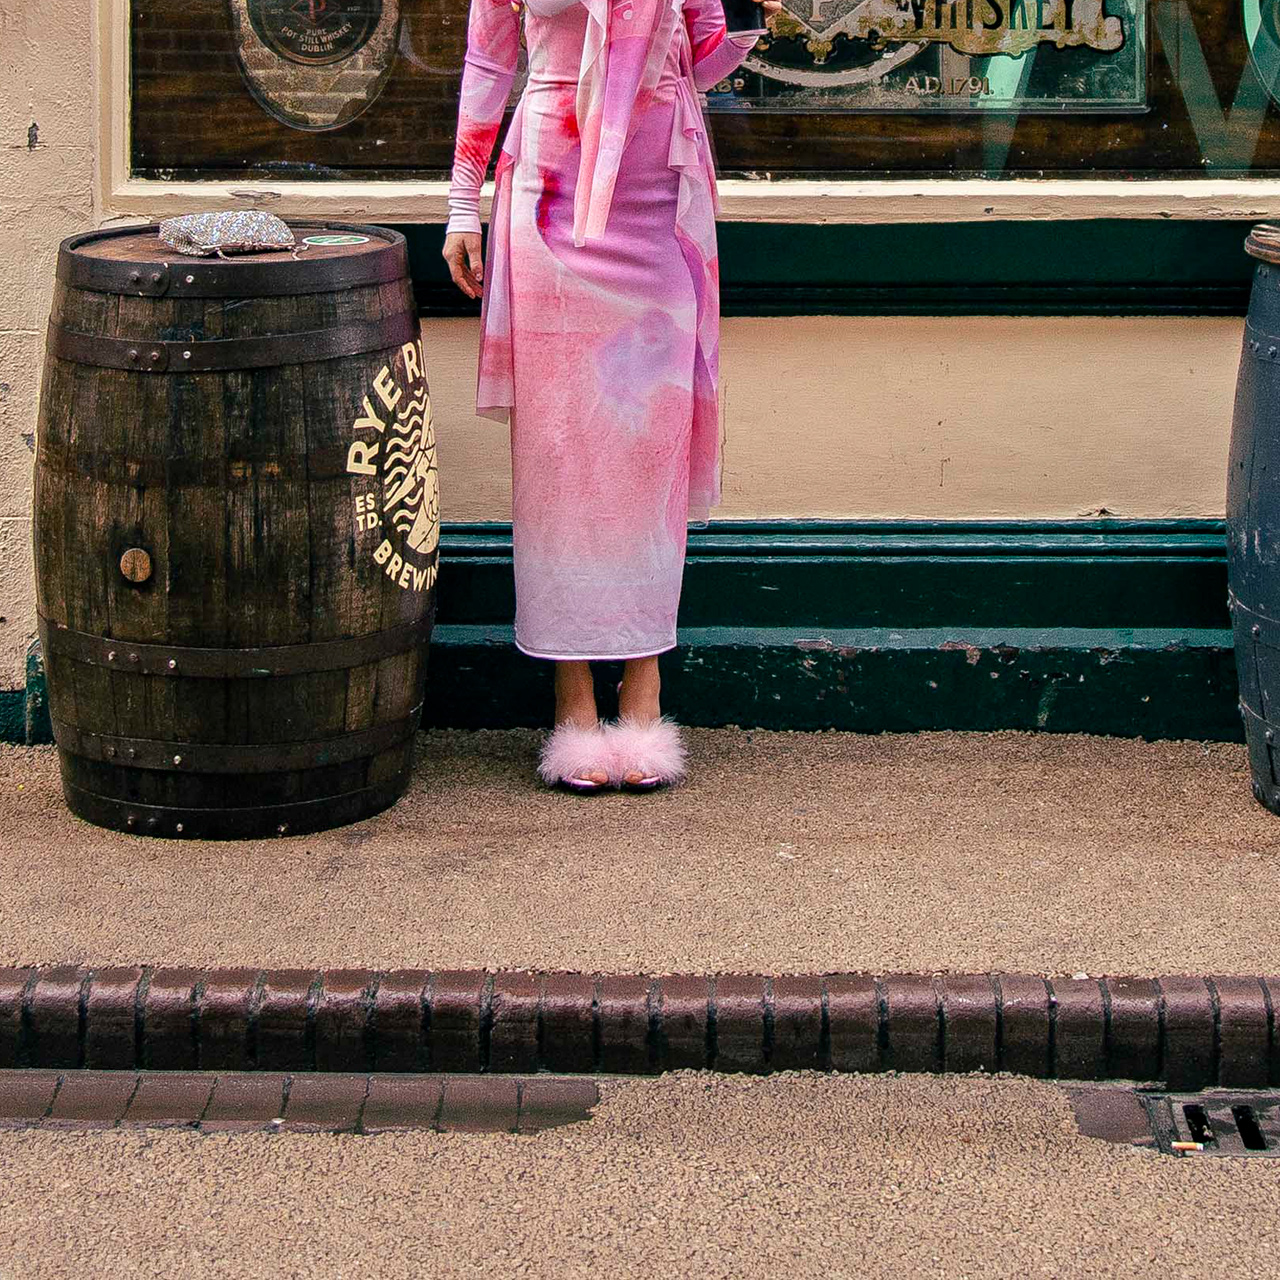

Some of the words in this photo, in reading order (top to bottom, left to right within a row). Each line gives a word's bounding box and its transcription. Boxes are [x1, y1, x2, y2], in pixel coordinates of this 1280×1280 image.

[281, 26, 298, 39] POT
[300, 34, 319, 44] STILL
[320, 22, 352, 43] WHISKEY
[301, 43, 333, 52] DUBLIN
[346, 365, 402, 476] RYE
[355, 493, 375, 513] ES
